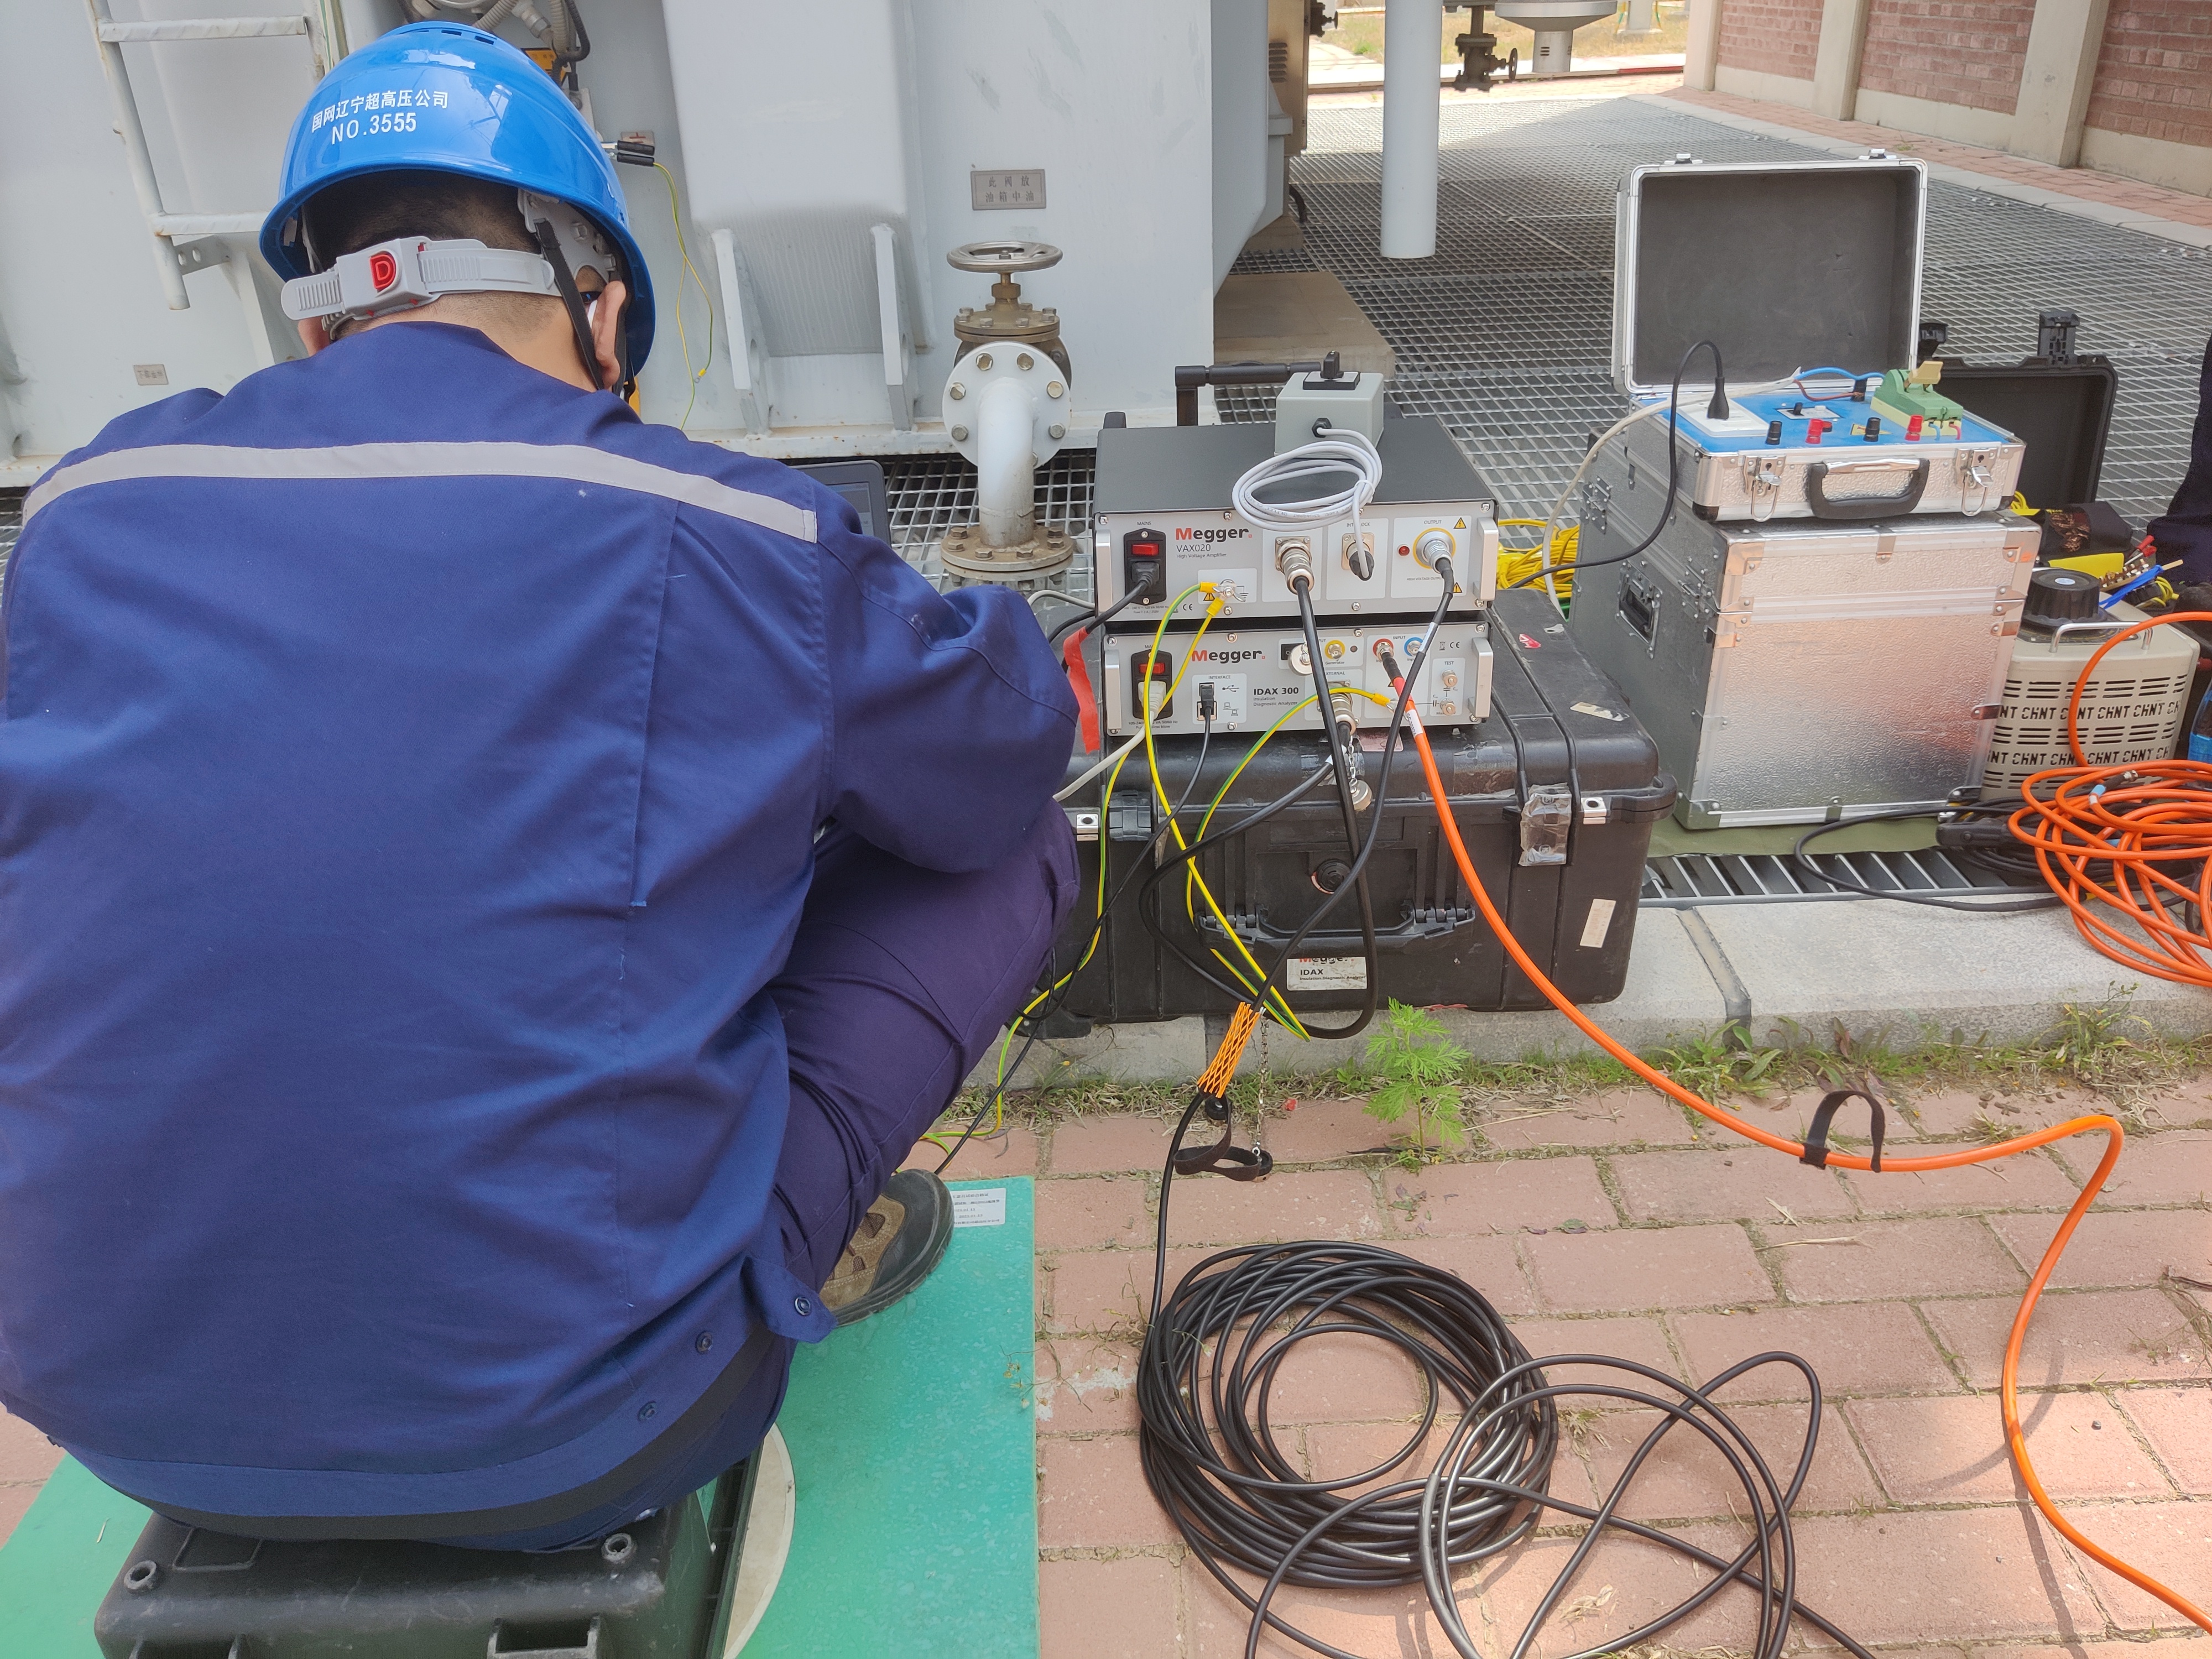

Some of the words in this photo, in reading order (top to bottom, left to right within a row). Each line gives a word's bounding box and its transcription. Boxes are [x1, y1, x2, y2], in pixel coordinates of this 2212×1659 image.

[311, 89, 448, 133] 国网辽宁超高压公司
[331, 112, 416, 145] NO.3555
[989, 175, 1030, 187] 此阀放
[985, 190, 1034, 203] 油箱中油
[1176, 544, 1211, 552] VAX020
[2000, 706, 2018, 718] NT
[2021, 706, 2056, 719] CHNT
[2060, 707, 2095, 719] CNT
[2098, 706, 2131, 719] CHNT
[2133, 702, 2165, 717] CHNT
[1987, 750, 2008, 764] NT
[2012, 753, 2047, 765] CHNT
[2050, 753, 2084, 765] CHN
[2087, 752, 2120, 765] CHNT
[2122, 748, 2154, 763] CHNT
